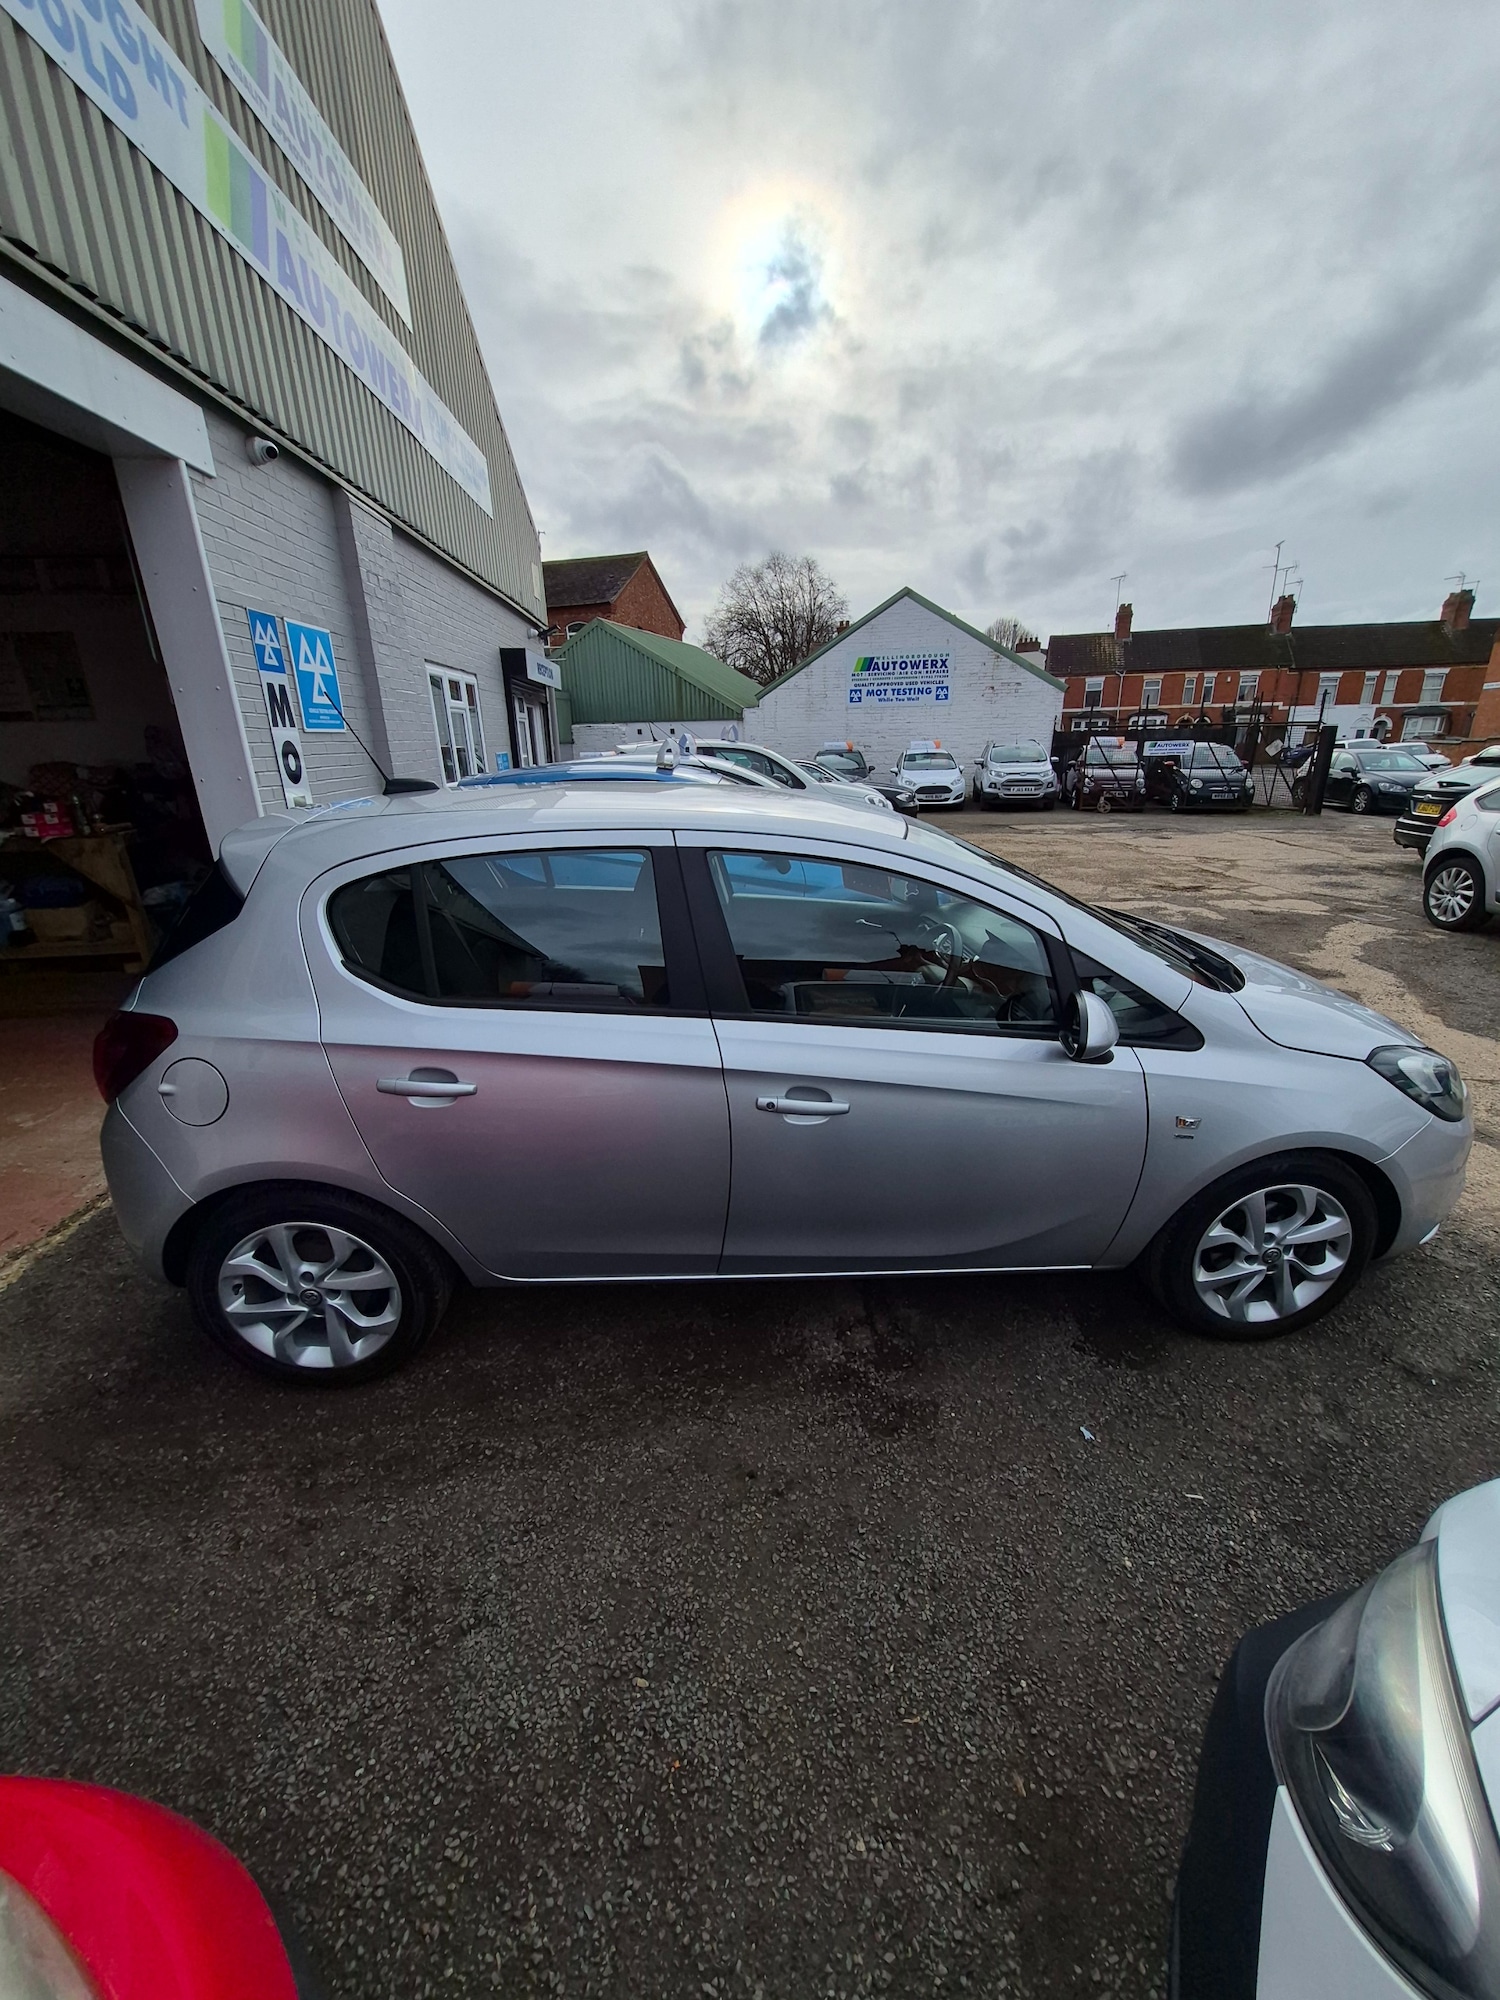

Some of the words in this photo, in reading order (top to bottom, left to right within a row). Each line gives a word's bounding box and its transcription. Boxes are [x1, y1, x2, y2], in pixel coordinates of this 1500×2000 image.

[17, 0, 138, 120] OLD
[79, 0, 189, 128] GHT
[866, 689, 888, 697] MOT
[892, 687, 932, 696] TESTING
[872, 659, 948, 671] AUTOWERX
